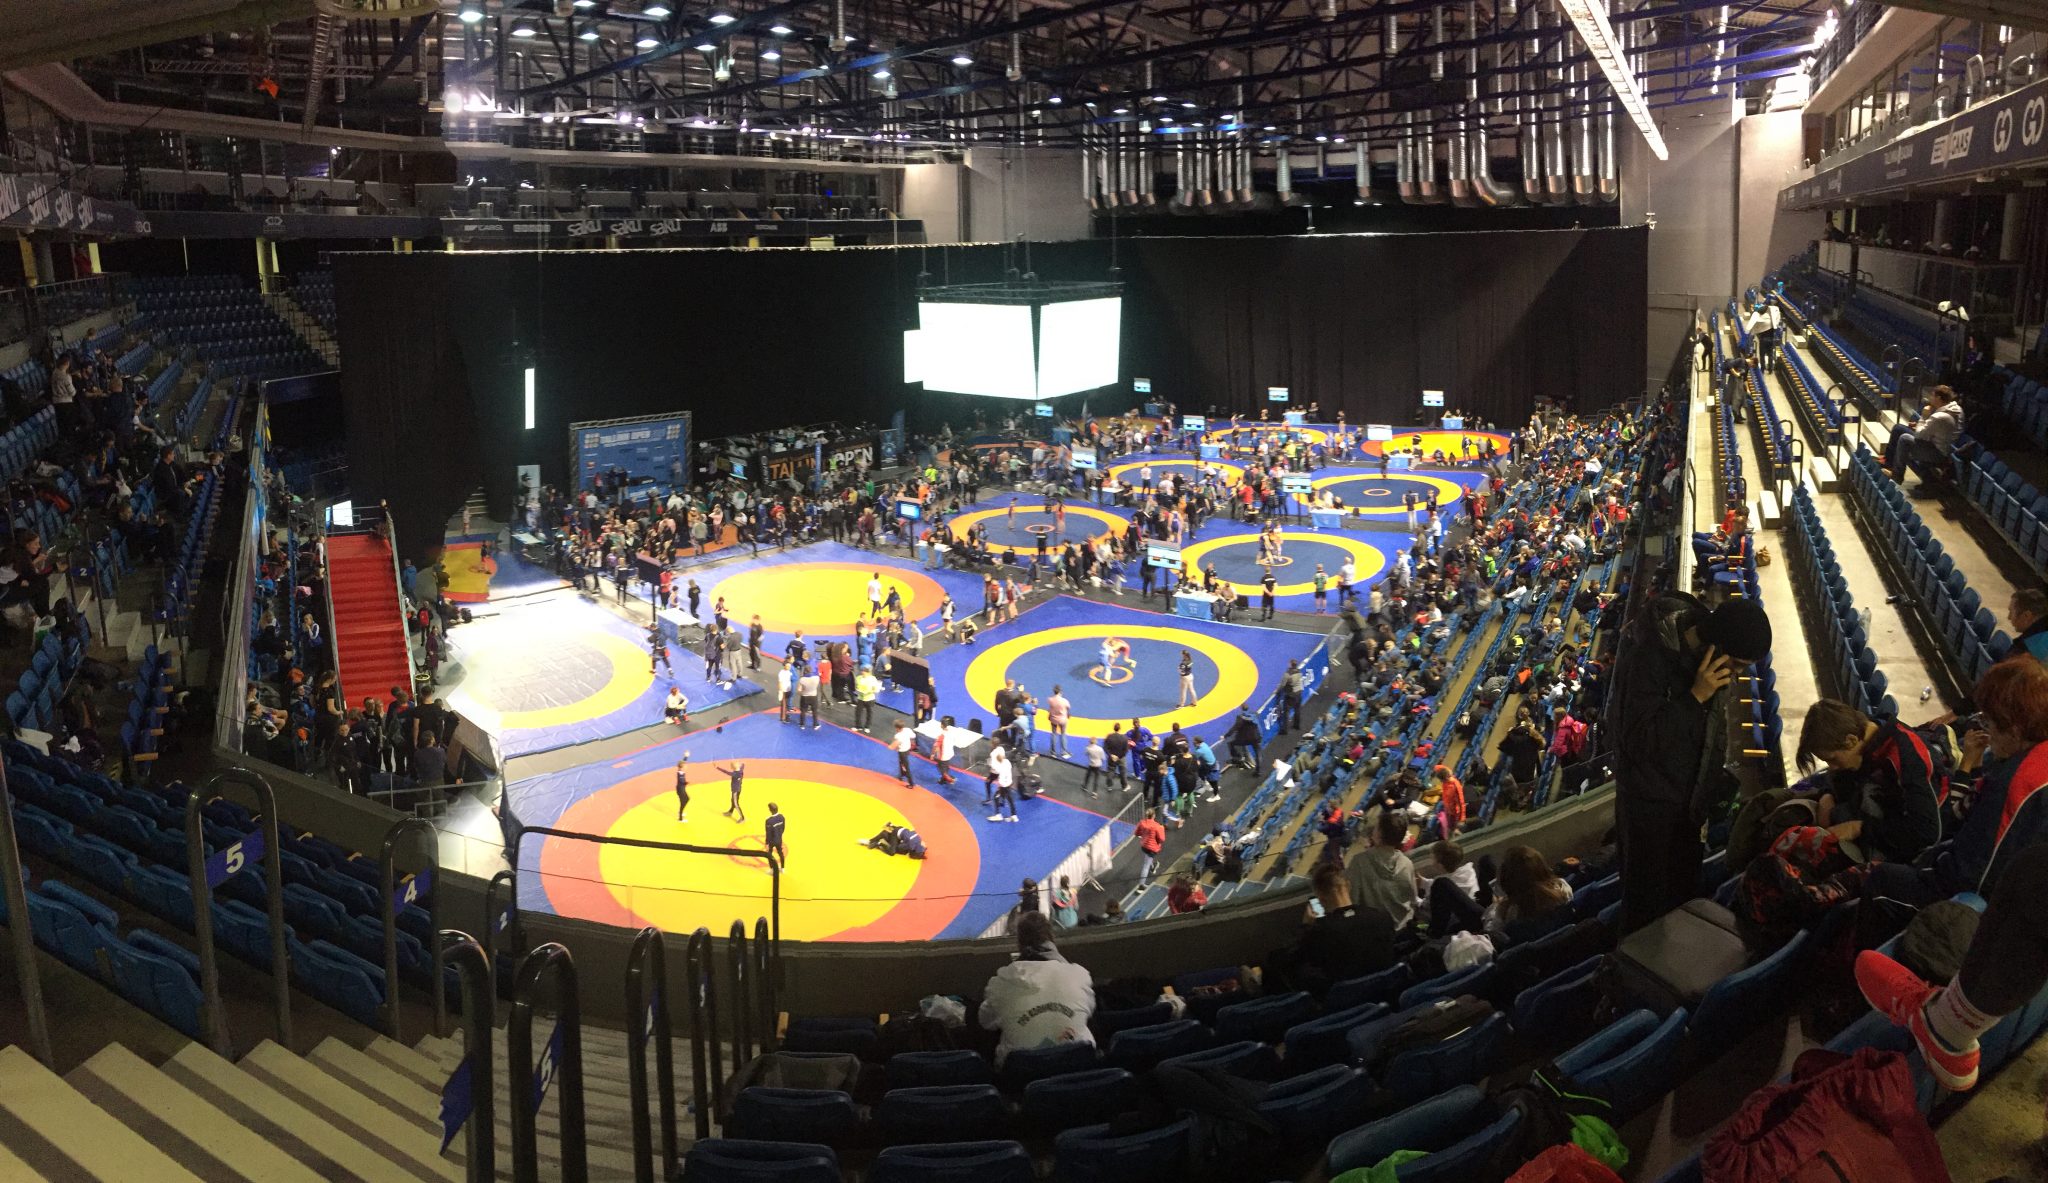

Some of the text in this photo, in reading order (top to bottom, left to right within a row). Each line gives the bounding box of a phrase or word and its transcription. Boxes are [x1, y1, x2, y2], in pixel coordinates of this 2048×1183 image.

[567, 219, 602, 237] saku
[610, 219, 642, 237] saku
[649, 219, 681, 237] saku
[80, 567, 87, 576] 2
[226, 842, 244, 874] 5
[404, 880, 417, 903] 4
